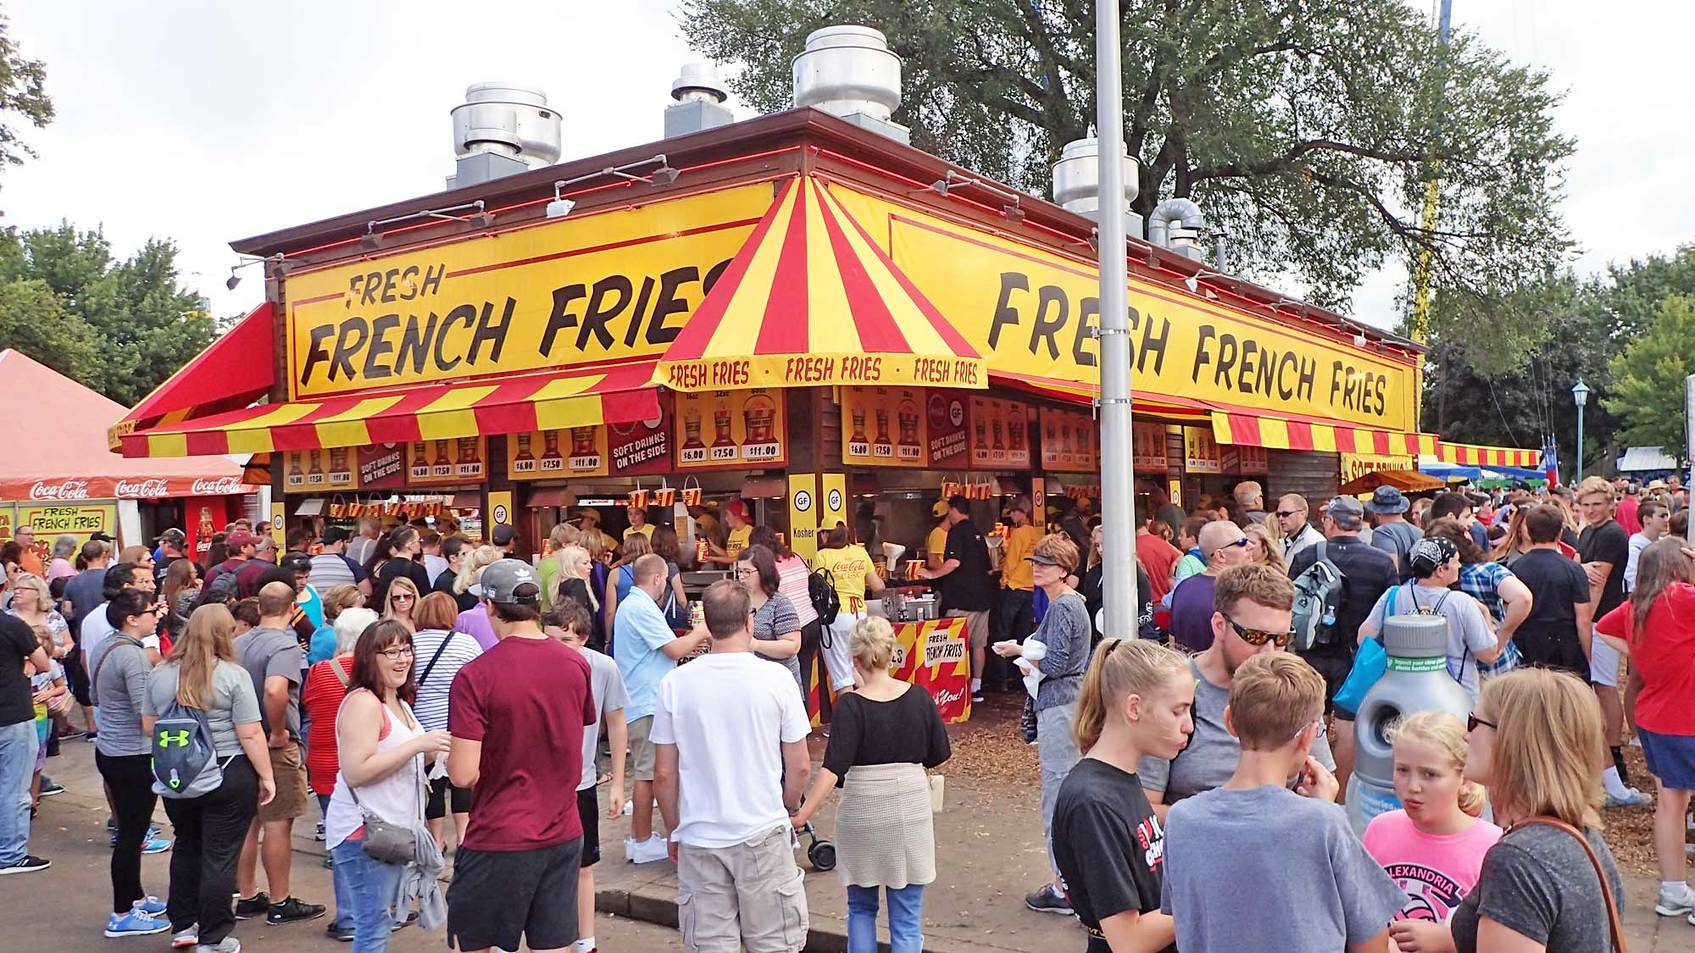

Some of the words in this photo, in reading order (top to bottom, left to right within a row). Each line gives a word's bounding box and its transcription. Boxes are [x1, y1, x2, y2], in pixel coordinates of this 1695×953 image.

[345, 263, 445, 310] FRESH
[301, 296, 517, 387] FRENCH
[668, 363, 707, 388] FRESH
[713, 361, 750, 385] FRIES
[786, 356, 834, 382] FRESH
[840, 356, 882, 381] FRIES
[914, 358, 950, 382] FRESH
[953, 361, 978, 385] FRIES
[1192, 325, 1316, 403] FRENCH
[1330, 360, 1387, 416] FRIES
[613, 442, 634, 458] SOFT
[635, 432, 666, 449] DRINKS
[750, 446, 776, 456] $11.00
[876, 446, 891, 455] $7.50
[617, 458, 629, 469] ON
[629, 451, 646, 466] THE
[646, 443, 666, 459] SIDE
[683, 450, 704, 460] $6.00
[713, 448, 734, 458] $7.50
[516, 461, 533, 470] $6.00
[543, 459, 561, 469] $7.50
[575, 457, 598, 467] $11.00
[30, 480, 90, 499] Coca-Cola
[114, 479, 169, 498] Coca-Cola
[192, 477, 243, 494] Coca-Cola
[796, 497, 808, 505] GF
[831, 496, 839, 505] GF
[43, 507, 79, 517] FRESH
[495, 510, 504, 519] GF
[33, 517, 71, 531] FRENCH
[73, 516, 101, 529] FRIES
[793, 528, 815, 538] Kosher
[928, 634, 948, 644] FRESH
[943, 643, 963, 658] FRIES
[1386, 865, 1454, 895] LEXANDRIA
